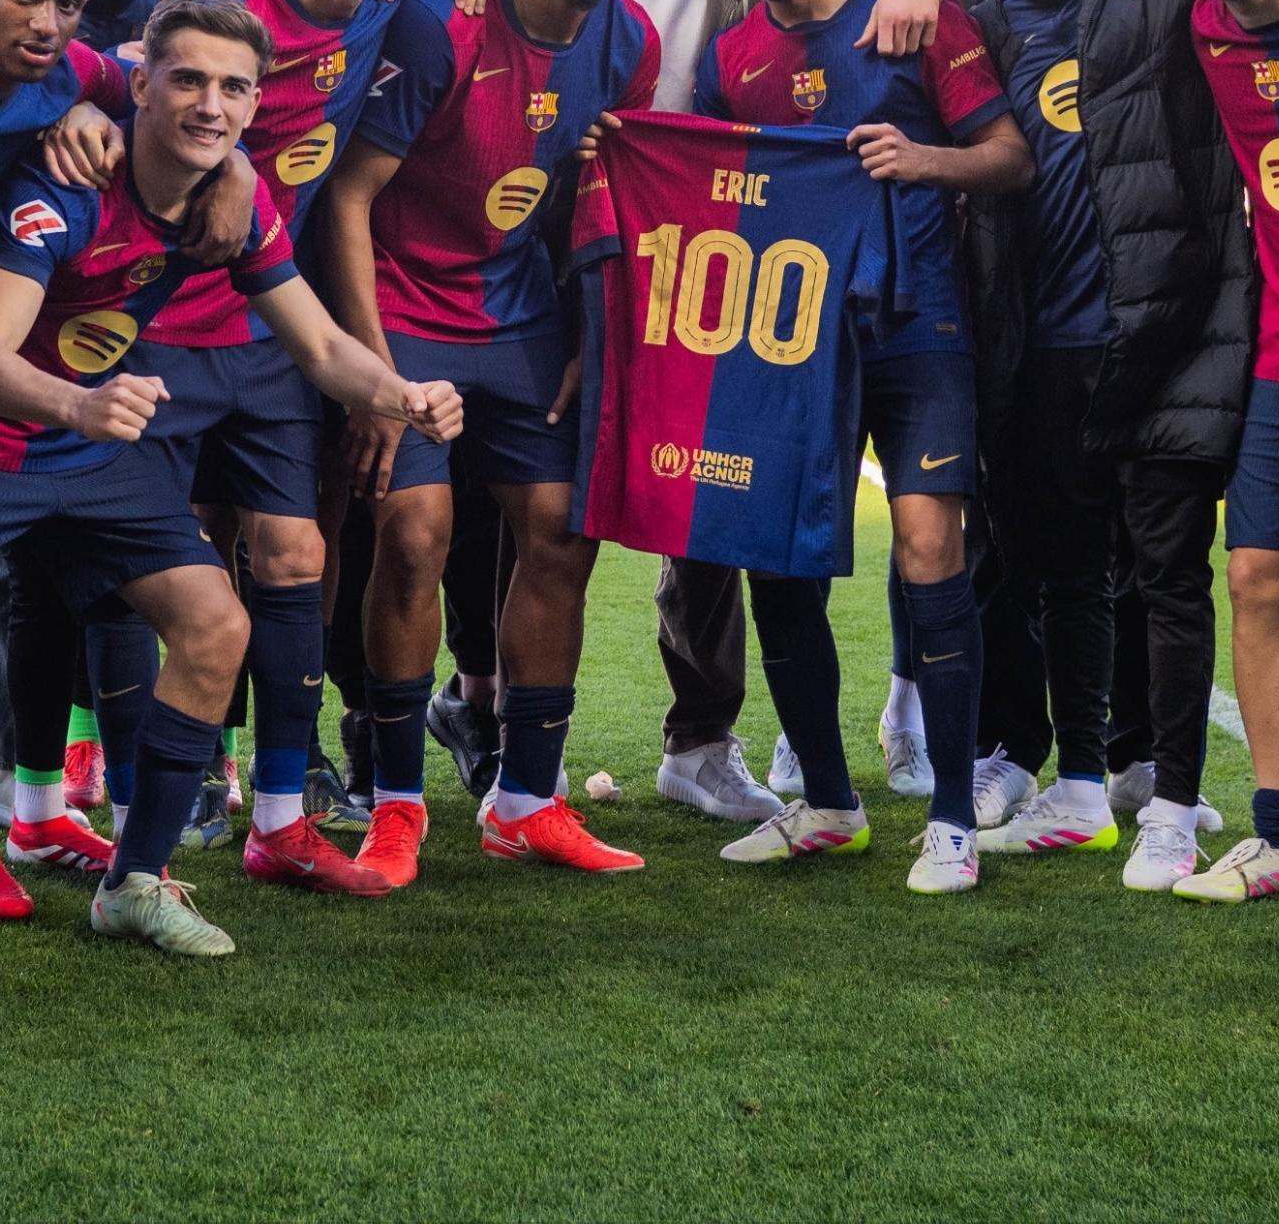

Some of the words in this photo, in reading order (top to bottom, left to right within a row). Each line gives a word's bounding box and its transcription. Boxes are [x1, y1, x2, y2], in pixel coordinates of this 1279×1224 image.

[711, 168, 770, 207] ERIC
[637, 223, 829, 365] 100
[689, 463, 752, 485] ACNUR
[692, 448, 754, 471] UNHCR
